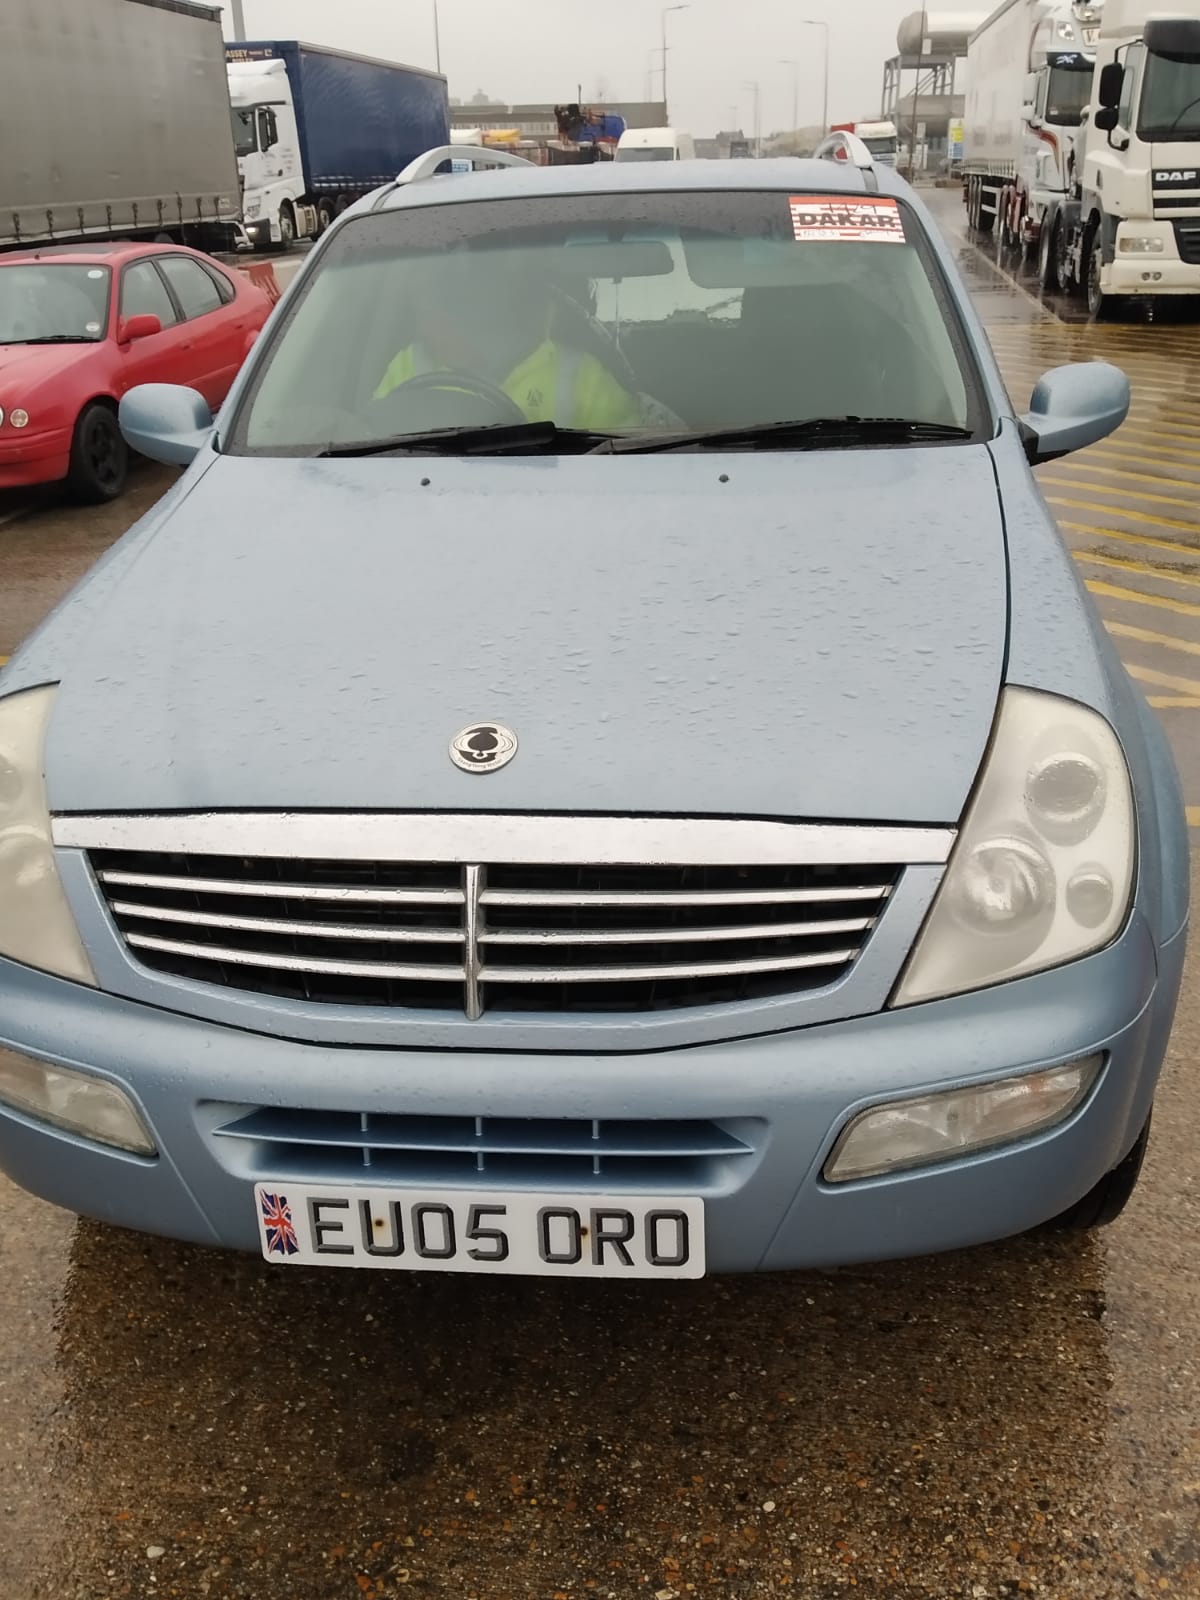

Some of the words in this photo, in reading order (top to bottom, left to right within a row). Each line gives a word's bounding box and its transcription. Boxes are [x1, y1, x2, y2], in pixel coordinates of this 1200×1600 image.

[1155, 171, 1196, 181] DAF
[798, 212, 897, 228] DAKAR
[305, 1196, 510, 1262] EU05
[537, 1205, 690, 1267] ORO
